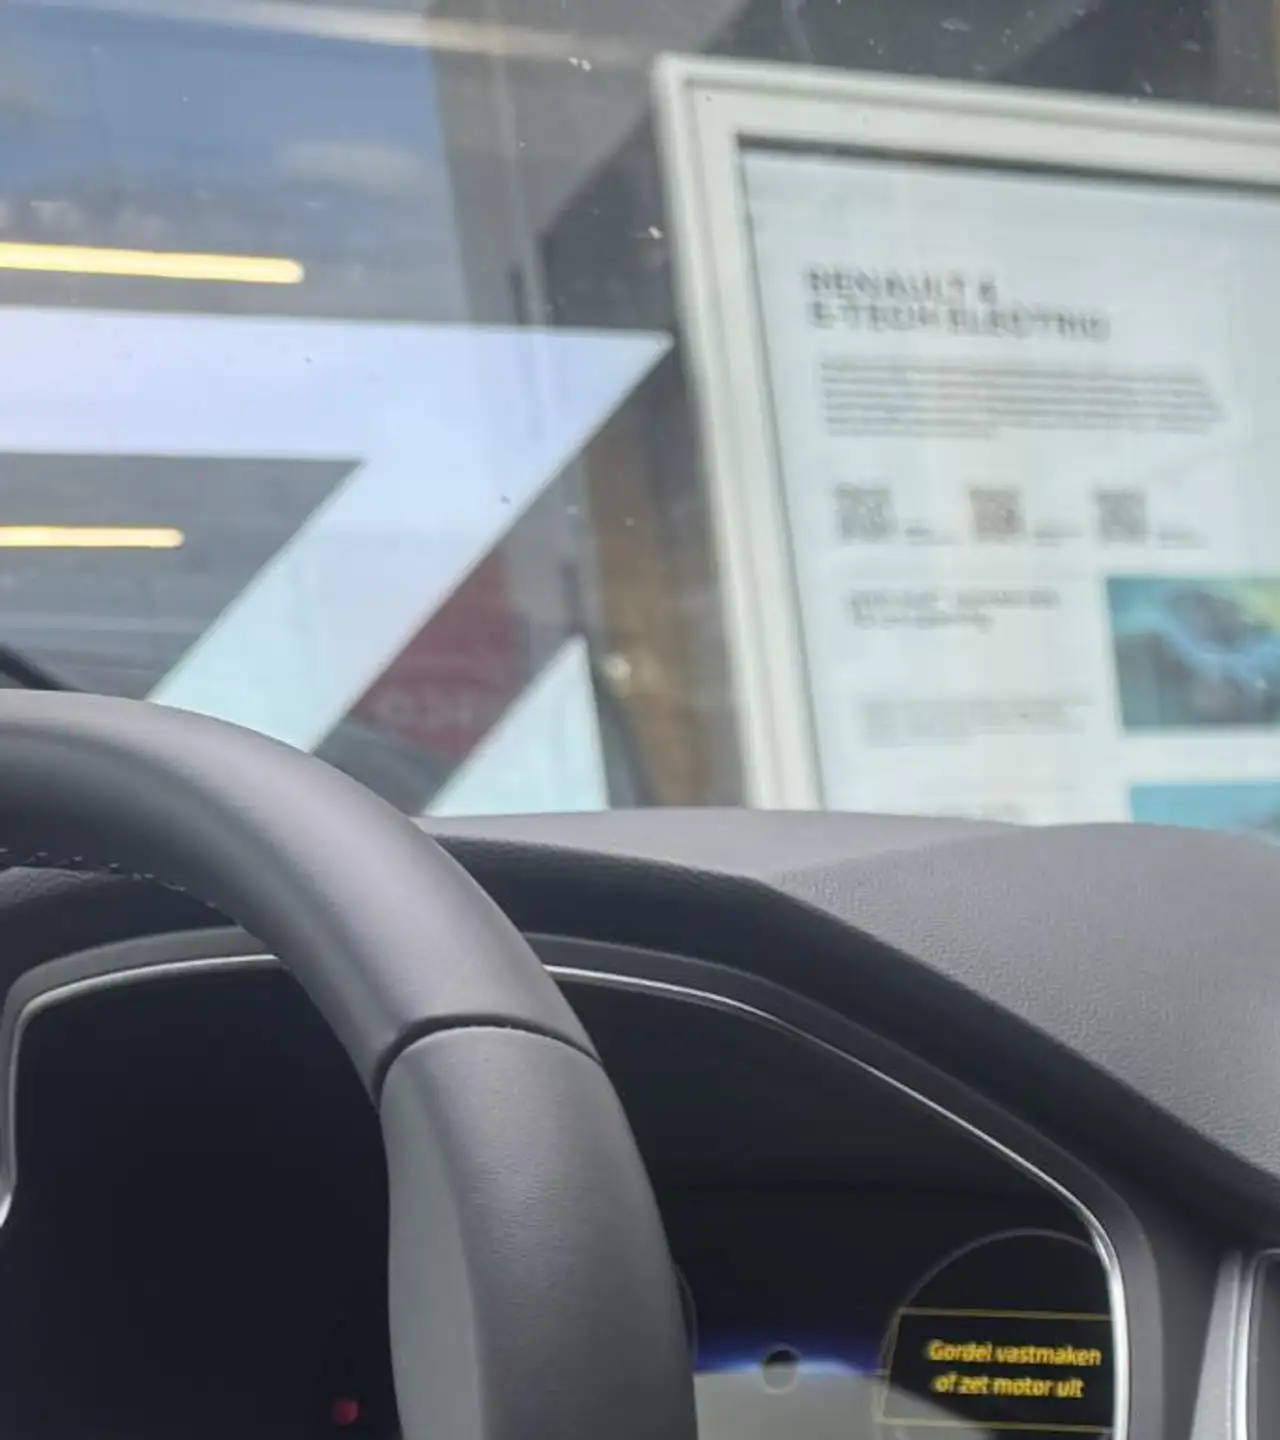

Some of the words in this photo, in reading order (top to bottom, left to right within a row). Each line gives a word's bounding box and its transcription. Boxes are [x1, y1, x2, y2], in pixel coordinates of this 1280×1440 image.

[927, 1338, 992, 1362] Gordel
[996, 1343, 1102, 1367] vastmaken
[931, 1372, 957, 1393] of
[994, 1376, 1051, 1398] motor
